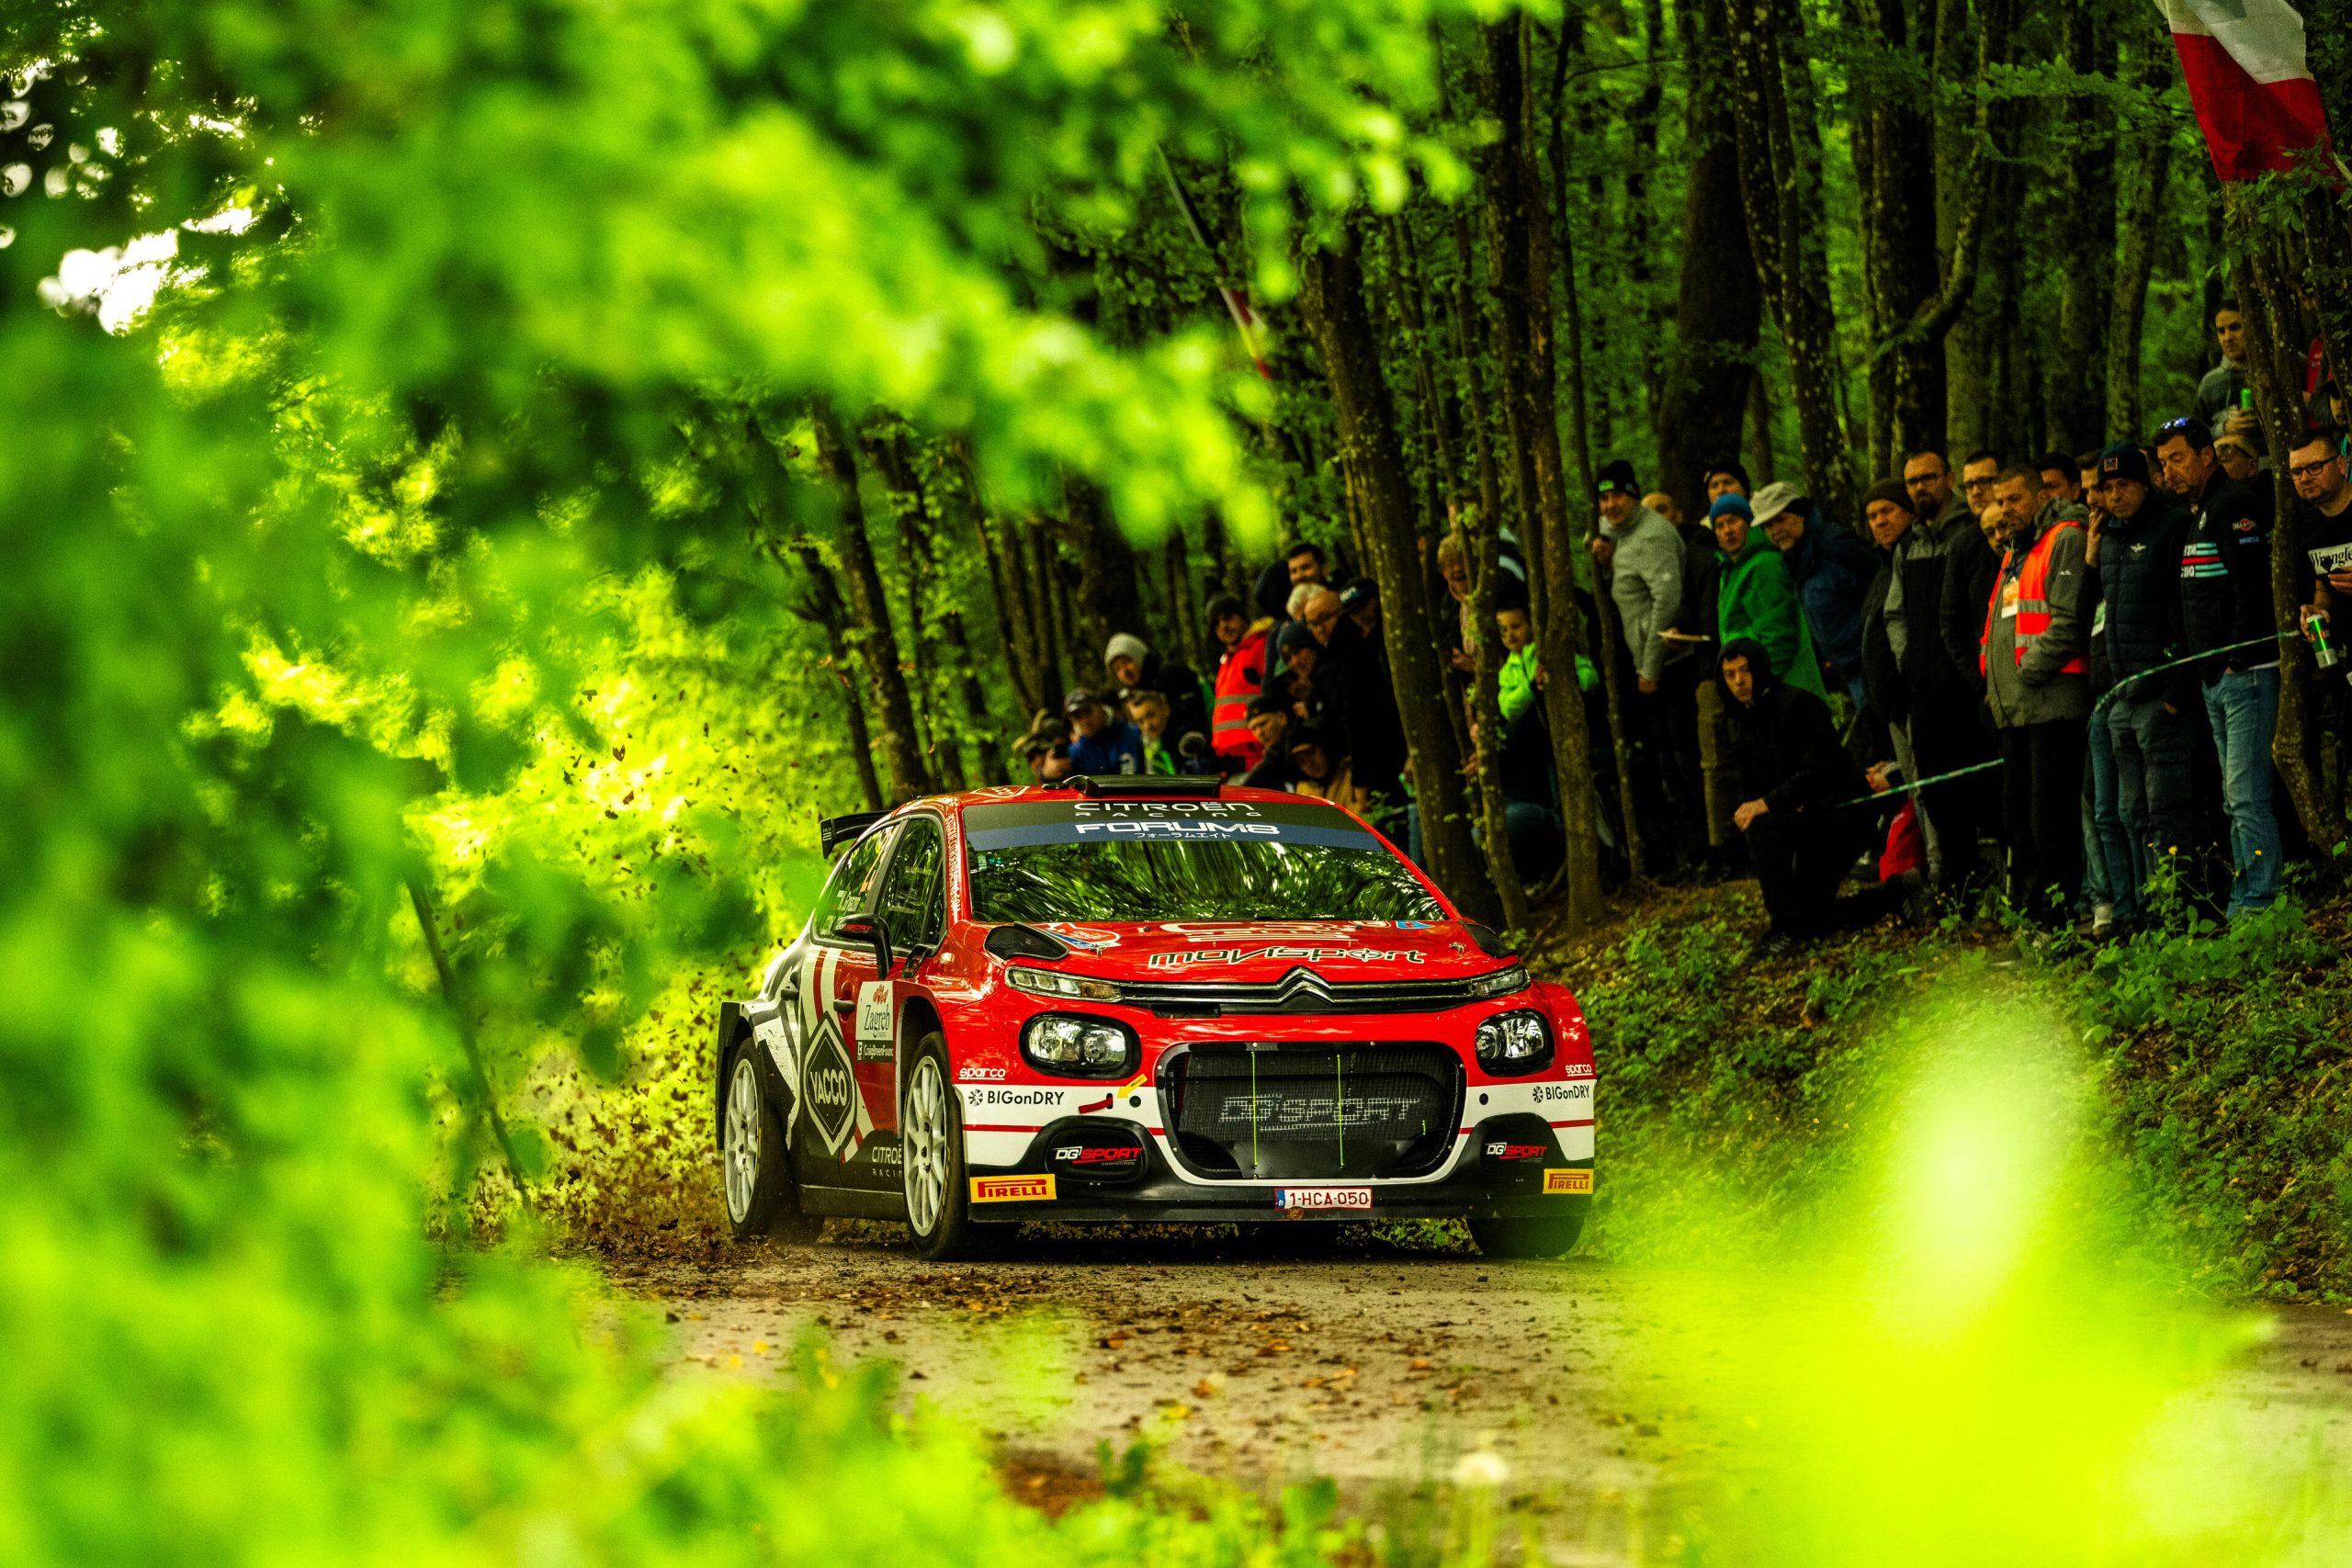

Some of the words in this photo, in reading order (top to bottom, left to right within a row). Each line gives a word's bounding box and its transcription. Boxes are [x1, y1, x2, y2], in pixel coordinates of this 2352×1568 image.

[2310, 547, 2352, 568] Wrngle
[1073, 801, 1255, 811] CITROËN
[1074, 821, 1281, 835] FORUM8
[864, 1004, 890, 1038] Zagreb
[958, 1067, 1006, 1080] sparco
[1565, 1064, 1592, 1077] sparco
[809, 1067, 847, 1107] YACCO
[1545, 1085, 1590, 1100] BIGonDRY
[987, 1090, 1065, 1106] BIGonDRY
[977, 1179, 1047, 1198] PIRELLI
[1547, 1173, 1589, 1190] PIRELLI
[1288, 1192, 1369, 1206] 1-HCA-050
